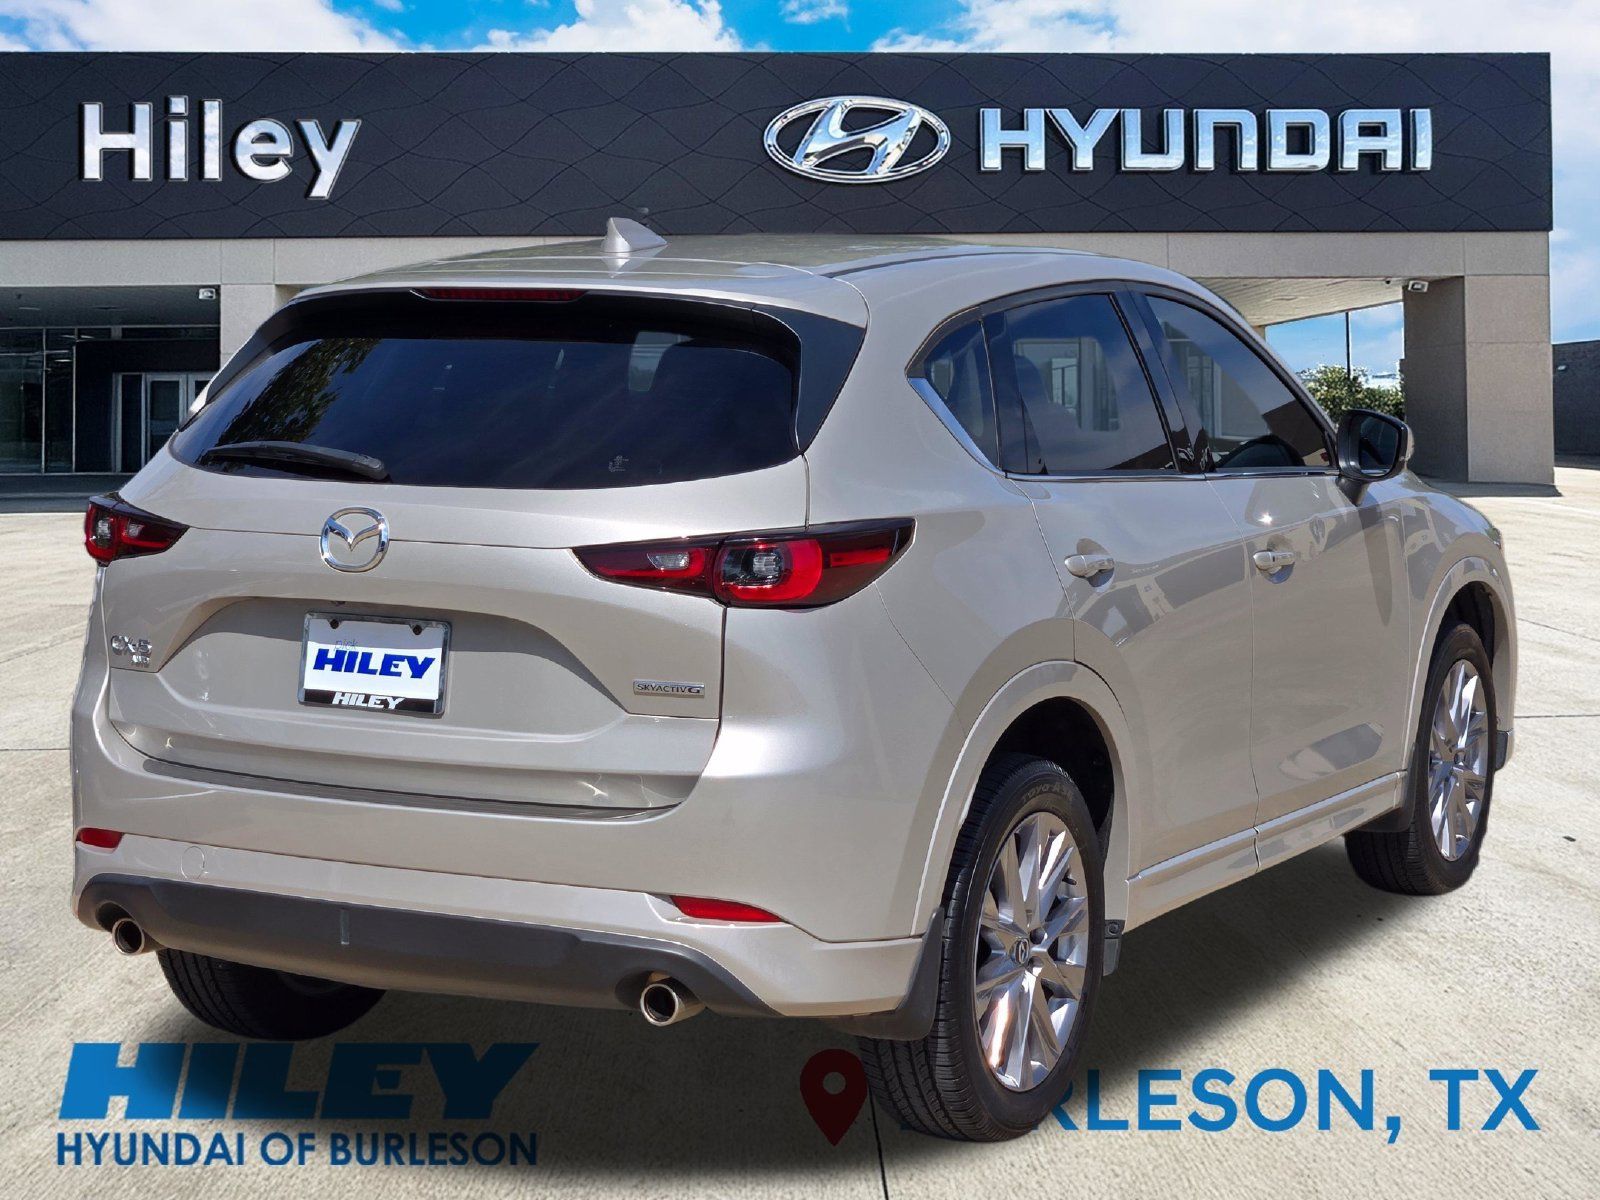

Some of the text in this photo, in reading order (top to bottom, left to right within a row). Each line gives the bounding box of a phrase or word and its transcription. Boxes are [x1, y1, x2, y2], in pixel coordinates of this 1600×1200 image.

[80, 95, 362, 199] Hiley
[979, 107, 1433, 171] HYUNDAI
[313, 648, 436, 679] HILEY
[332, 692, 405, 709] HILEY
